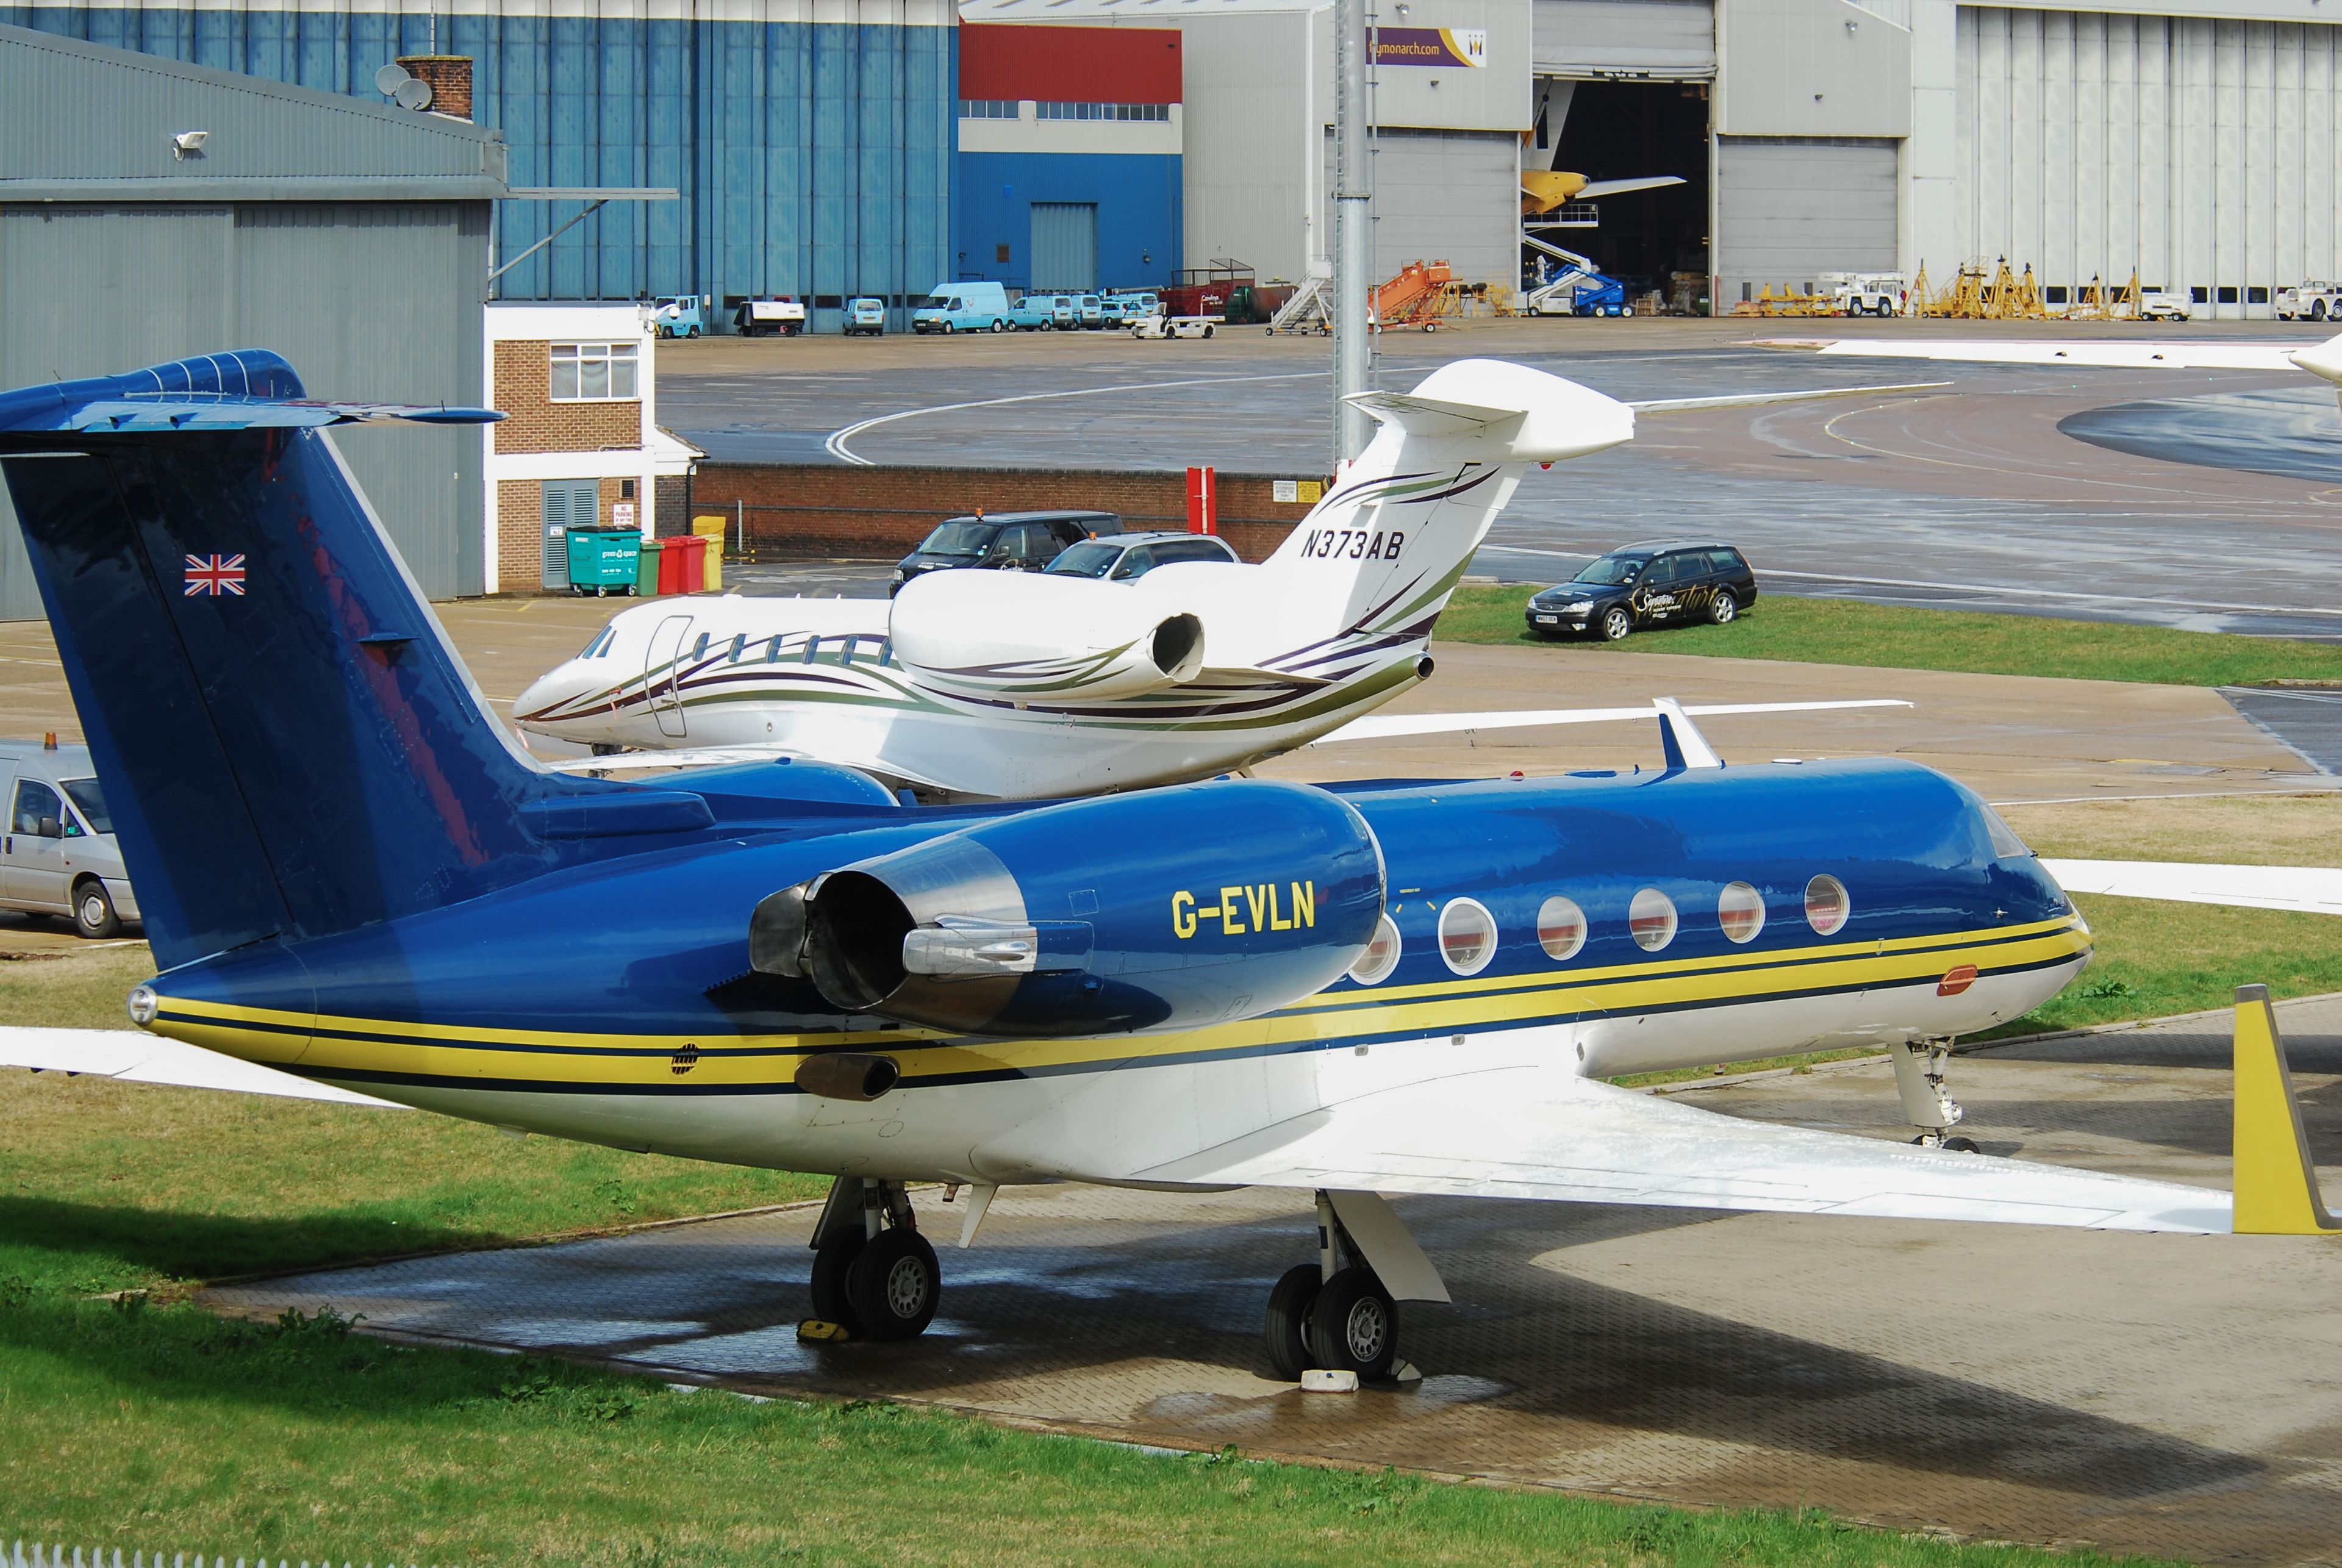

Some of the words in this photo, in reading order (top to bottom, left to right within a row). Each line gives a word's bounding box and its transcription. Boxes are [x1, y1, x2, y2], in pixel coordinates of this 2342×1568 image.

[1369, 40, 1439, 57] fymonarch.com
[1300, 529, 1405, 560] N373AB
[1171, 880, 1316, 939] G-EVLN
